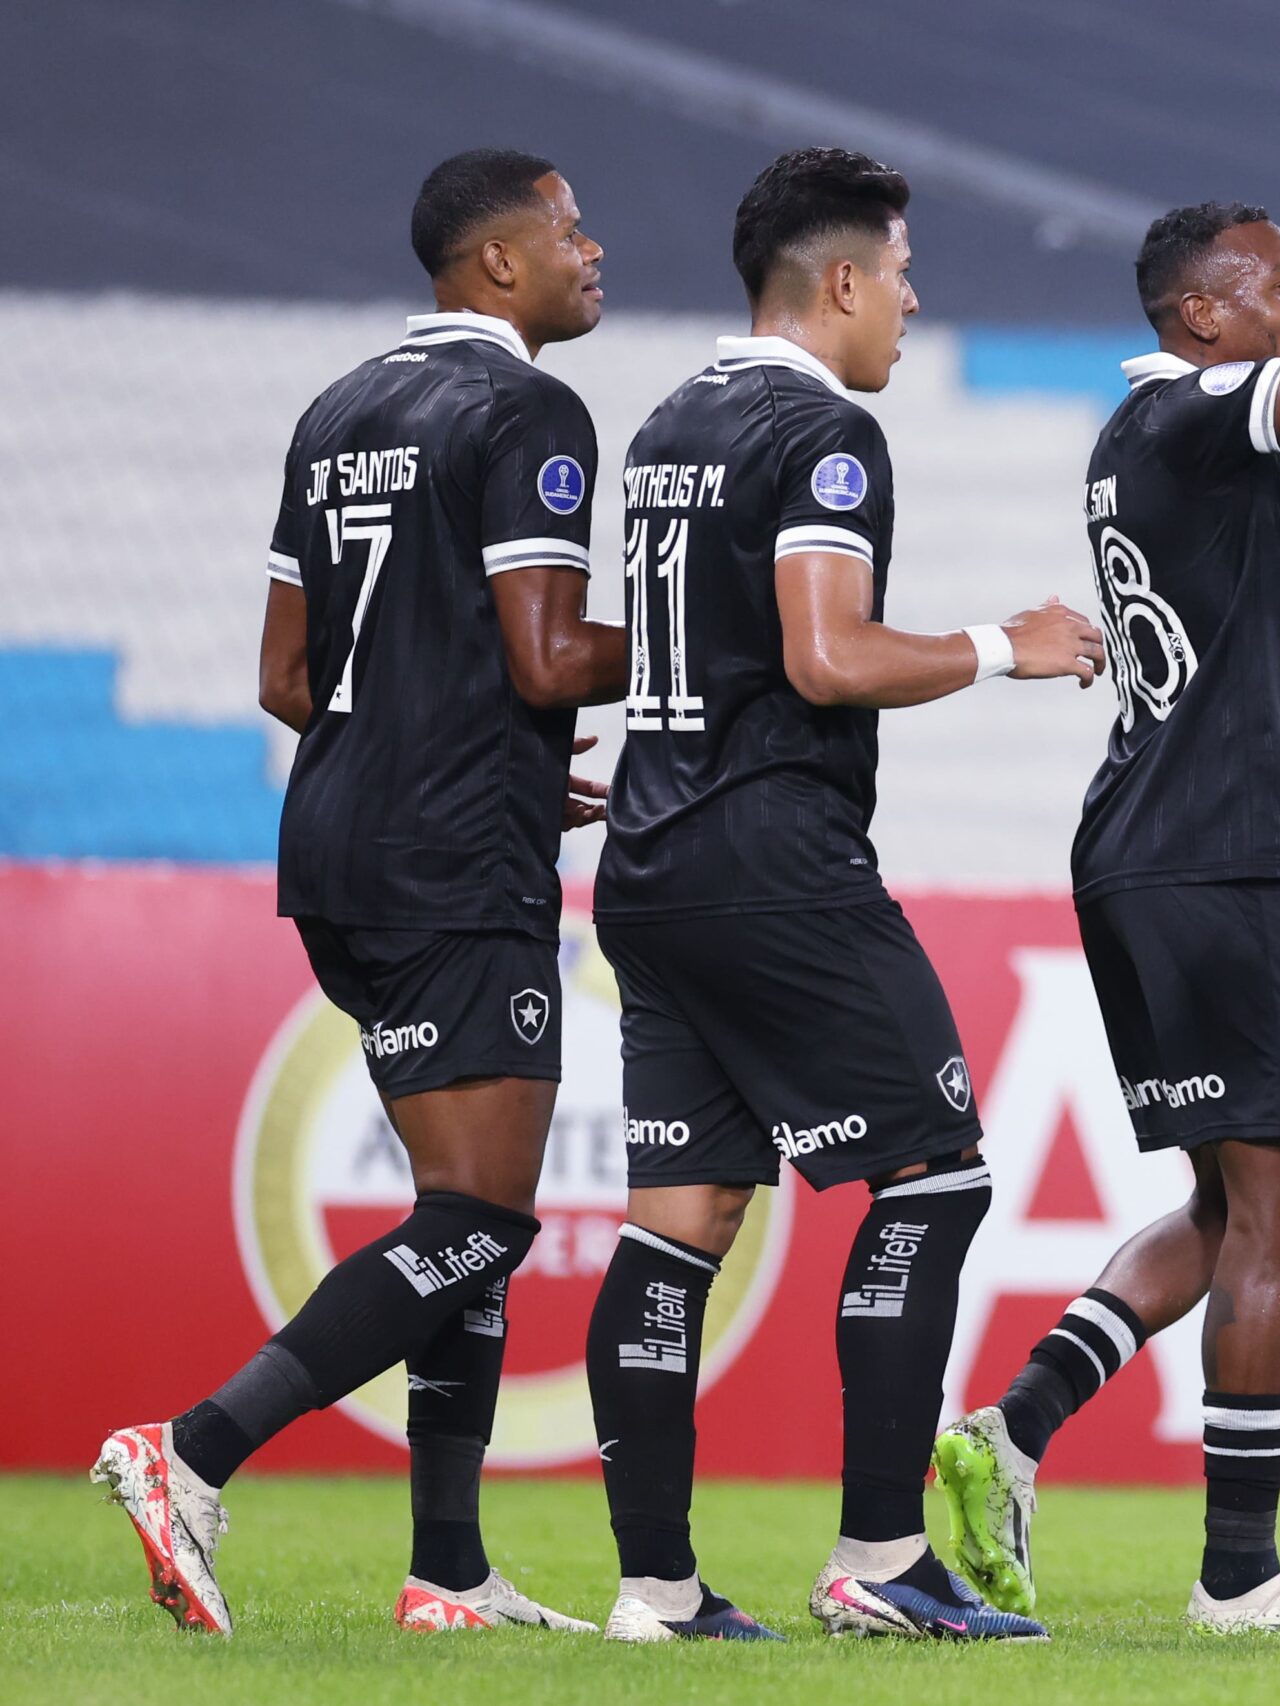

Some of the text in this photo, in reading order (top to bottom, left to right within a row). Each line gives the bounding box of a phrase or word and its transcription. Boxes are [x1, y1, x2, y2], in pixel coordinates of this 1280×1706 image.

[306, 446, 420, 506] JR SANTOS
[623, 464, 726, 510] MATHEUS M.
[324, 503, 393, 714] 7
[625, 518, 706, 732] 11
[1089, 525, 1199, 734] 8
[424, 1230, 509, 1288] Lifefit
[862, 1221, 930, 1293] Lifefit
[644, 1281, 687, 1350] Lifefit
